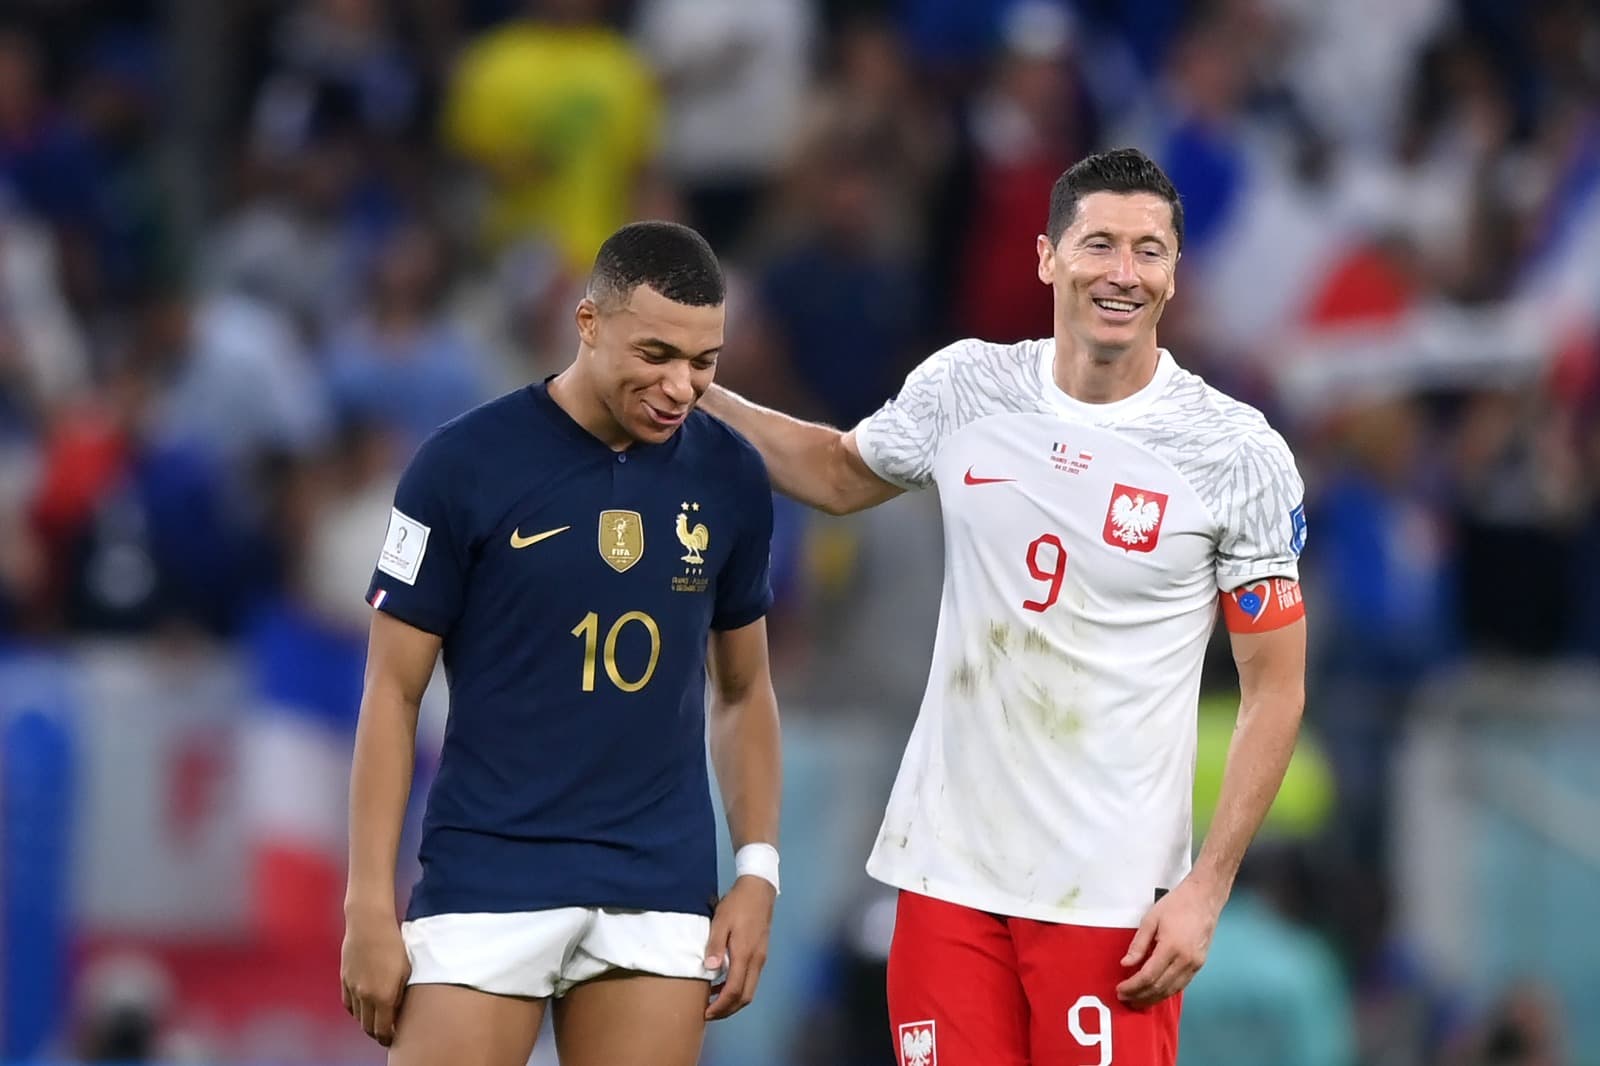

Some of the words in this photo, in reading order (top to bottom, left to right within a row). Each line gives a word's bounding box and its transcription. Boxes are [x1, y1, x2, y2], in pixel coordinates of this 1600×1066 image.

[612, 548, 630, 556] FIFA
[1023, 533, 1067, 613] 9
[1278, 590, 1296, 612] FOR
[571, 610, 660, 692] 10
[1067, 995, 1113, 1066] 9
